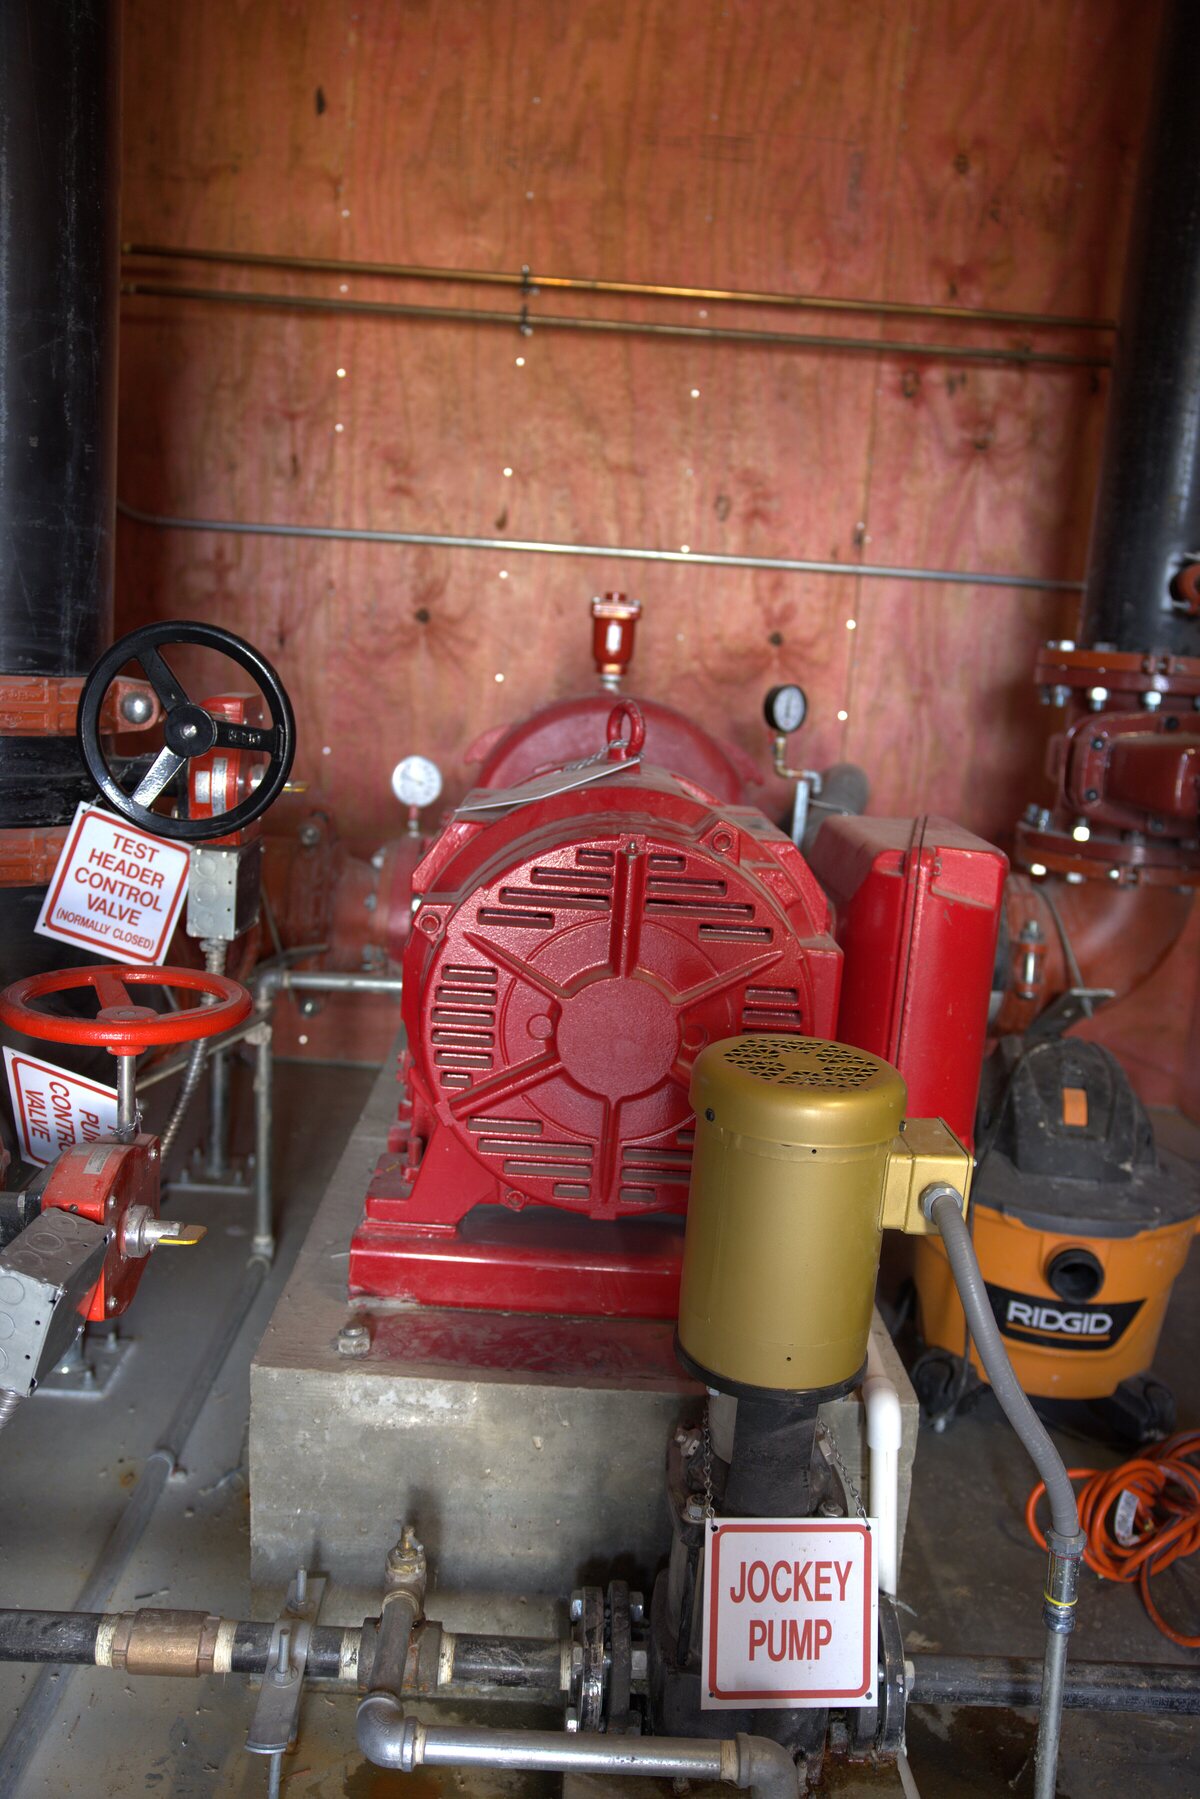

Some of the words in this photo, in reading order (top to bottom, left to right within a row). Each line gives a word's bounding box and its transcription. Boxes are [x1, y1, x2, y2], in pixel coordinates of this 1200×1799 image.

[88, 848, 165, 890] HEADER
[113, 832, 160, 863] TEST
[74, 867, 163, 912] CONTROL
[87, 893, 142, 927] VALVE
[56, 908, 111, 935] (NORMALLY
[112, 928, 155, 951] CLOSED)
[25, 1089, 51, 1143] VALVE
[49, 1081, 76, 1151] CONTR
[1006, 1300, 1114, 1335] RIDGID
[730, 1560, 853, 1604] JOCKEY
[748, 1619, 833, 1662] PUMP
